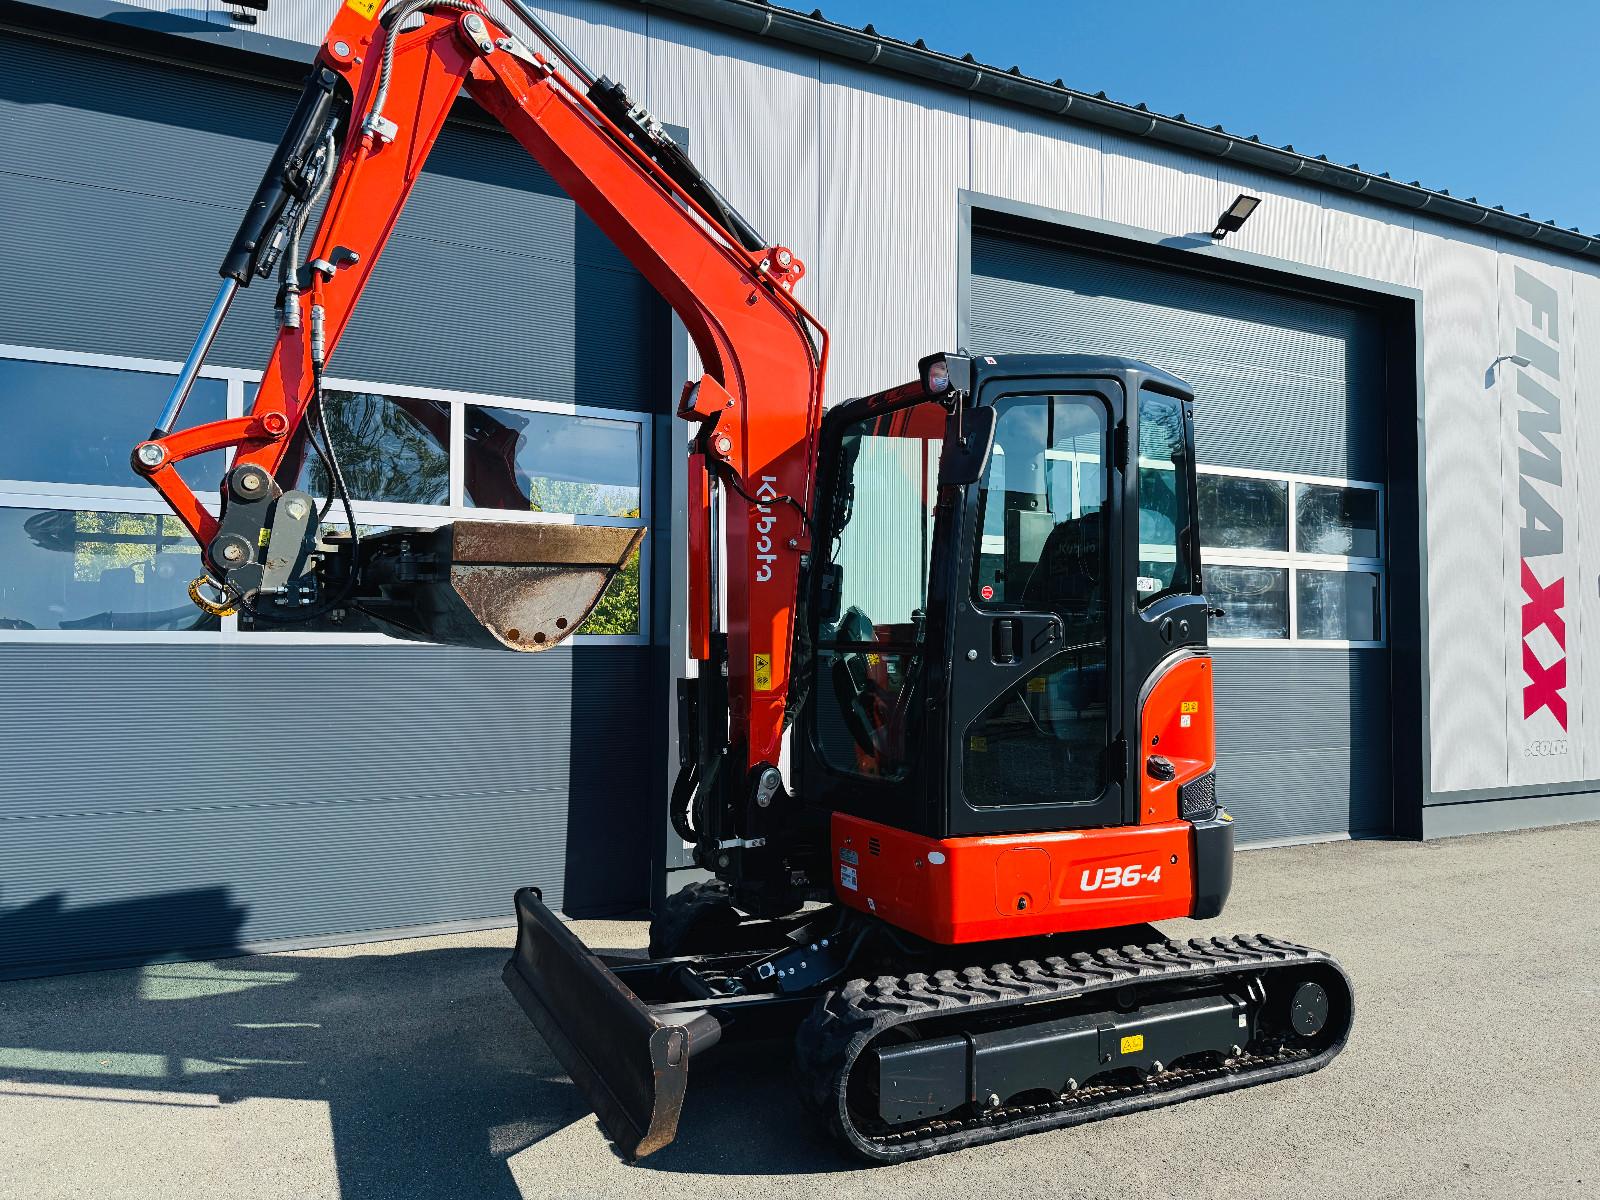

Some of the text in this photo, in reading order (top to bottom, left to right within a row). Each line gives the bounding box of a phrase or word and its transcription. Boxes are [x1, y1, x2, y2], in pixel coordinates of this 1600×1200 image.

[756, 475, 777, 582] Kubota
[1514, 264, 1567, 733] FIMAXX
[1080, 864, 1161, 892] U36-4
